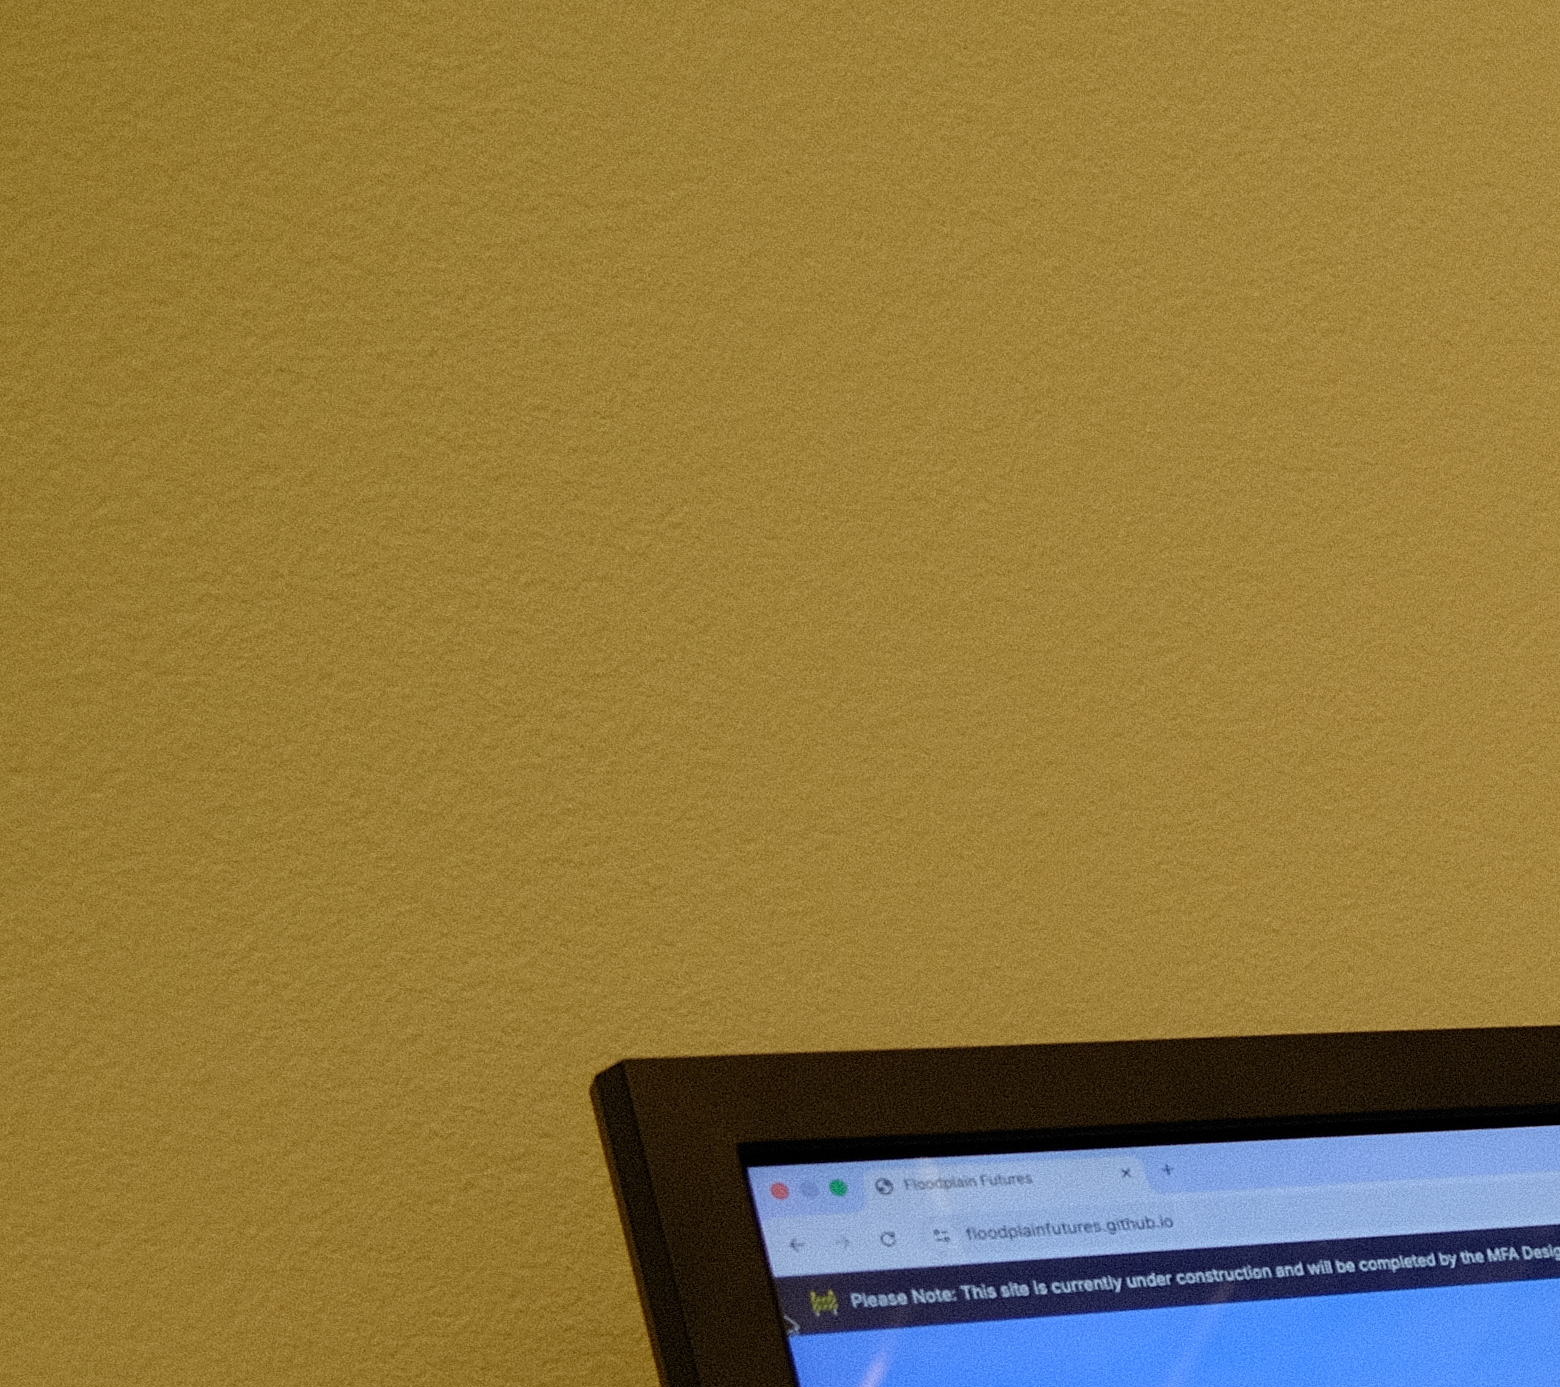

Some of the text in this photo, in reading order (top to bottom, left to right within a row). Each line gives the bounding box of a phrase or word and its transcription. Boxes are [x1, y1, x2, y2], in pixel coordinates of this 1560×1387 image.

[979, 1172, 1034, 1188] Futures
[851, 1291, 907, 1309] Please
[912, 1288, 957, 1304] Note:
[961, 1285, 997, 1301] This
[1001, 1282, 1029, 1297] site
[1033, 1281, 1048, 1296] is
[1051, 1274, 1122, 1296] currently
[1127, 1271, 1172, 1288] under
[1175, 1263, 1272, 1285] construction
[1276, 1261, 1304, 1277] and
[1306, 1258, 1333, 1275] will
[1336, 1257, 1356, 1273] be
[1358, 1250, 1436, 1274] completed
[1440, 1250, 1457, 1269] by
[1460, 1249, 1484, 1265] the
[1487, 1245, 1519, 1262] MFA
